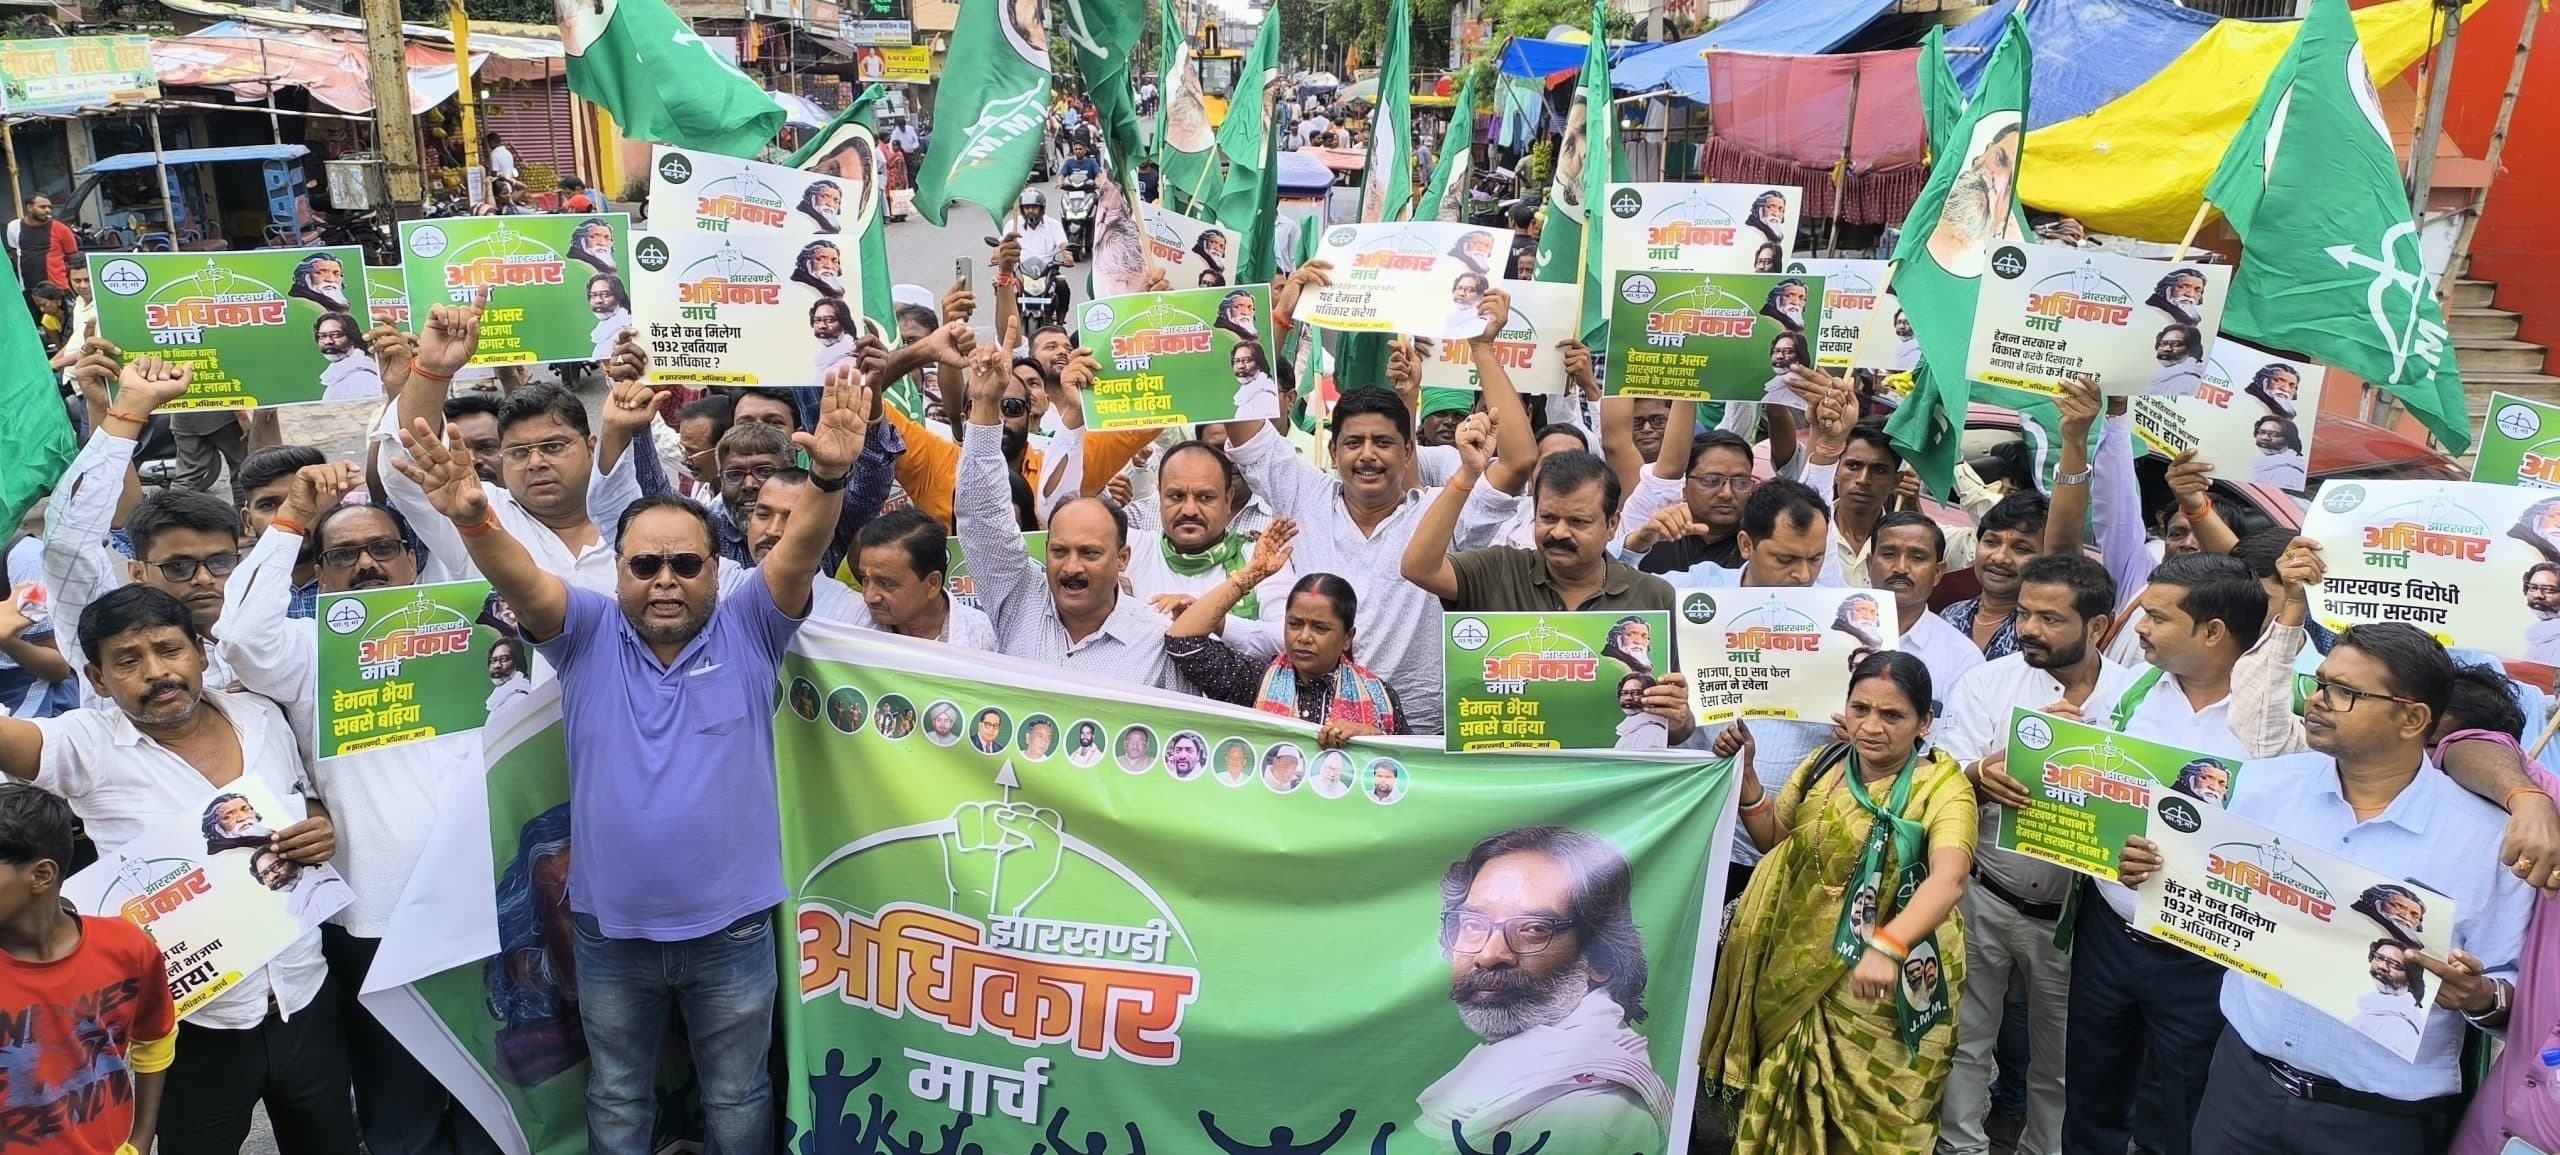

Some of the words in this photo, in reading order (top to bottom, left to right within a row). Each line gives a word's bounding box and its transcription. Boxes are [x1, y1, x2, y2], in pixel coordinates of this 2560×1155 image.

[696, 194, 788, 228] अधिकार
[744, 195, 782, 208] झारखण्डी
[696, 217, 730, 232] मार्च
[1648, 221, 1736, 246] अधिकार
[1352, 249, 1436, 272] अधिकार
[1648, 246, 1680, 260] मार्च
[445, 256, 564, 287] अधिकार
[729, 274, 774, 283] झारखण्डी
[1351, 268, 1380, 281] मार्च
[214, 290, 275, 304] झारखण्डी
[678, 277, 781, 305] अधिकार
[1320, 292, 1334, 302] यह
[1335, 291, 1362, 304] हेमन्त
[1364, 292, 1372, 304] है
[2082, 291, 2128, 305] झारखण्डी
[147, 297, 287, 329] अधिकार
[492, 308, 524, 323] असर
[680, 302, 718, 321] मार्च
[1314, 304, 1350, 317] प्रतिकार
[1351, 306, 1376, 318] करेगा
[1703, 307, 1750, 318] झारखण्डी
[2026, 291, 2132, 326] अधिकार
[480, 324, 512, 338] भाजपा
[650, 322, 668, 340] केंद्र
[670, 324, 682, 338] से
[684, 326, 703, 338] कब
[704, 323, 742, 338] मिलेगा
[1646, 308, 1756, 338] अधिकार
[1832, 324, 1860, 340] विरोधी
[2025, 314, 2062, 332] मार्च
[149, 327, 203, 345] मार्च
[510, 336, 520, 350] पर
[1112, 328, 1213, 357] अधिकार
[1647, 334, 1687, 348] मार्च
[1994, 329, 2020, 345] हेमन्त
[2022, 336, 2056, 350] सरकार
[2058, 339, 2067, 352] ने
[652, 341, 679, 353] 1932
[681, 340, 728, 354] खतियान
[1820, 341, 1852, 352] सरकार
[1992, 342, 2022, 358] विकास
[2022, 348, 2044, 362] करके
[2045, 351, 2076, 366] दिखाया
[2076, 356, 2084, 368] है
[654, 356, 668, 368] का
[670, 354, 712, 368] अधिकार
[1114, 355, 1152, 372] मार्च
[1627, 350, 1661, 367] हेमन्त
[1662, 352, 1678, 366] का
[1680, 352, 1708, 367] असर
[1990, 356, 2015, 370] भाजपा
[2016, 362, 2024, 372] ने
[2026, 362, 2044, 374] सिर्फ
[2046, 366, 2064, 378] कर्ज
[1626, 364, 1664, 376] झारखण्ड
[1666, 364, 1694, 377] भाजपा
[204, 381, 232, 394] लाना
[232, 380, 242, 392] है
[1093, 376, 1132, 395] हेमन्त
[1135, 374, 1164, 392] भैया
[1652, 375, 1660, 386] के
[1662, 376, 1686, 387] कगार
[1688, 377, 1700, 387] पर
[1094, 397, 1130, 414] सबसे
[1133, 394, 1172, 416] बढ़िया
[2176, 412, 2188, 426] पर
[2134, 409, 2160, 436] हाय!
[2162, 427, 2188, 452] हाय!
[2426, 522, 2484, 536] झारखण्डी
[2363, 522, 2491, 563] अधिकार
[2364, 550, 2410, 570] मार्च
[2323, 578, 2402, 596] झारखण्ड
[2406, 579, 2460, 605] विरोधी
[2324, 599, 2380, 618] भाजपा
[2382, 603, 2448, 624] सरकार
[416, 620, 465, 634] झारखण्डी
[1772, 624, 1815, 634] झारखण्डी
[359, 626, 472, 666] अधिकार
[1726, 627, 1821, 653] अधिकार
[1540, 648, 1590, 660] झारखण्डी
[1726, 648, 1761, 664] मार्च
[360, 660, 403, 680] मार्च
[1483, 651, 1598, 683] अधिकार
[1698, 666, 1732, 680] भाजपा,
[1734, 667, 1748, 677] ED
[1770, 664, 1790, 679] फेल
[1485, 679, 1528, 695] मार्च
[1698, 678, 1726, 694] हेमन्त
[1729, 678, 1740, 691] ने
[1743, 677, 1768, 692] खेला
[332, 688, 379, 713] हेमन्त
[382, 681, 414, 704] भैया
[1700, 692, 1720, 708] ऐसा
[1722, 690, 1744, 706] खेल
[1458, 700, 1504, 718] हेमन्त
[1506, 698, 1538, 716] भैया
[333, 711, 374, 736] सबसे
[378, 703, 420, 730] बढ़िया
[1459, 718, 1498, 736] सबसे
[1500, 716, 1545, 738] बढ़िया
[2044, 785, 2090, 807] मार्च
[2088, 821, 2096, 834] है
[2016, 824, 2042, 842] हेमन्त
[2044, 833, 2076, 851] सरकार
[2076, 842, 2102, 860] लाना
[2102, 846, 2110, 862] है
[144, 861, 192, 896] झारखण्डी
[2206, 852, 2336, 924] अधिकार
[2272, 871, 2327, 902] झारखण्डी
[2206, 874, 2254, 905] मार्च
[2164, 878, 2188, 903] केंद्र
[2189, 885, 2203, 904] से
[2205, 894, 2228, 913] कब
[2230, 898, 2277, 934] मिलेगा
[2160, 910, 2176, 928] का
[2178, 914, 2230, 948] अधिकार
[2163, 896, 2194, 919] 1932
[2198, 907, 2256, 942] खतियान
[989, 914, 1171, 963] झारखण्डी
[170, 940, 188, 958] पर
[184, 938, 224, 971] भाजपा
[800, 904, 1198, 1064] अधिकार
[1908, 1001, 1948, 1034] J.M.M.
[903, 1047, 1051, 1126] मार्च
